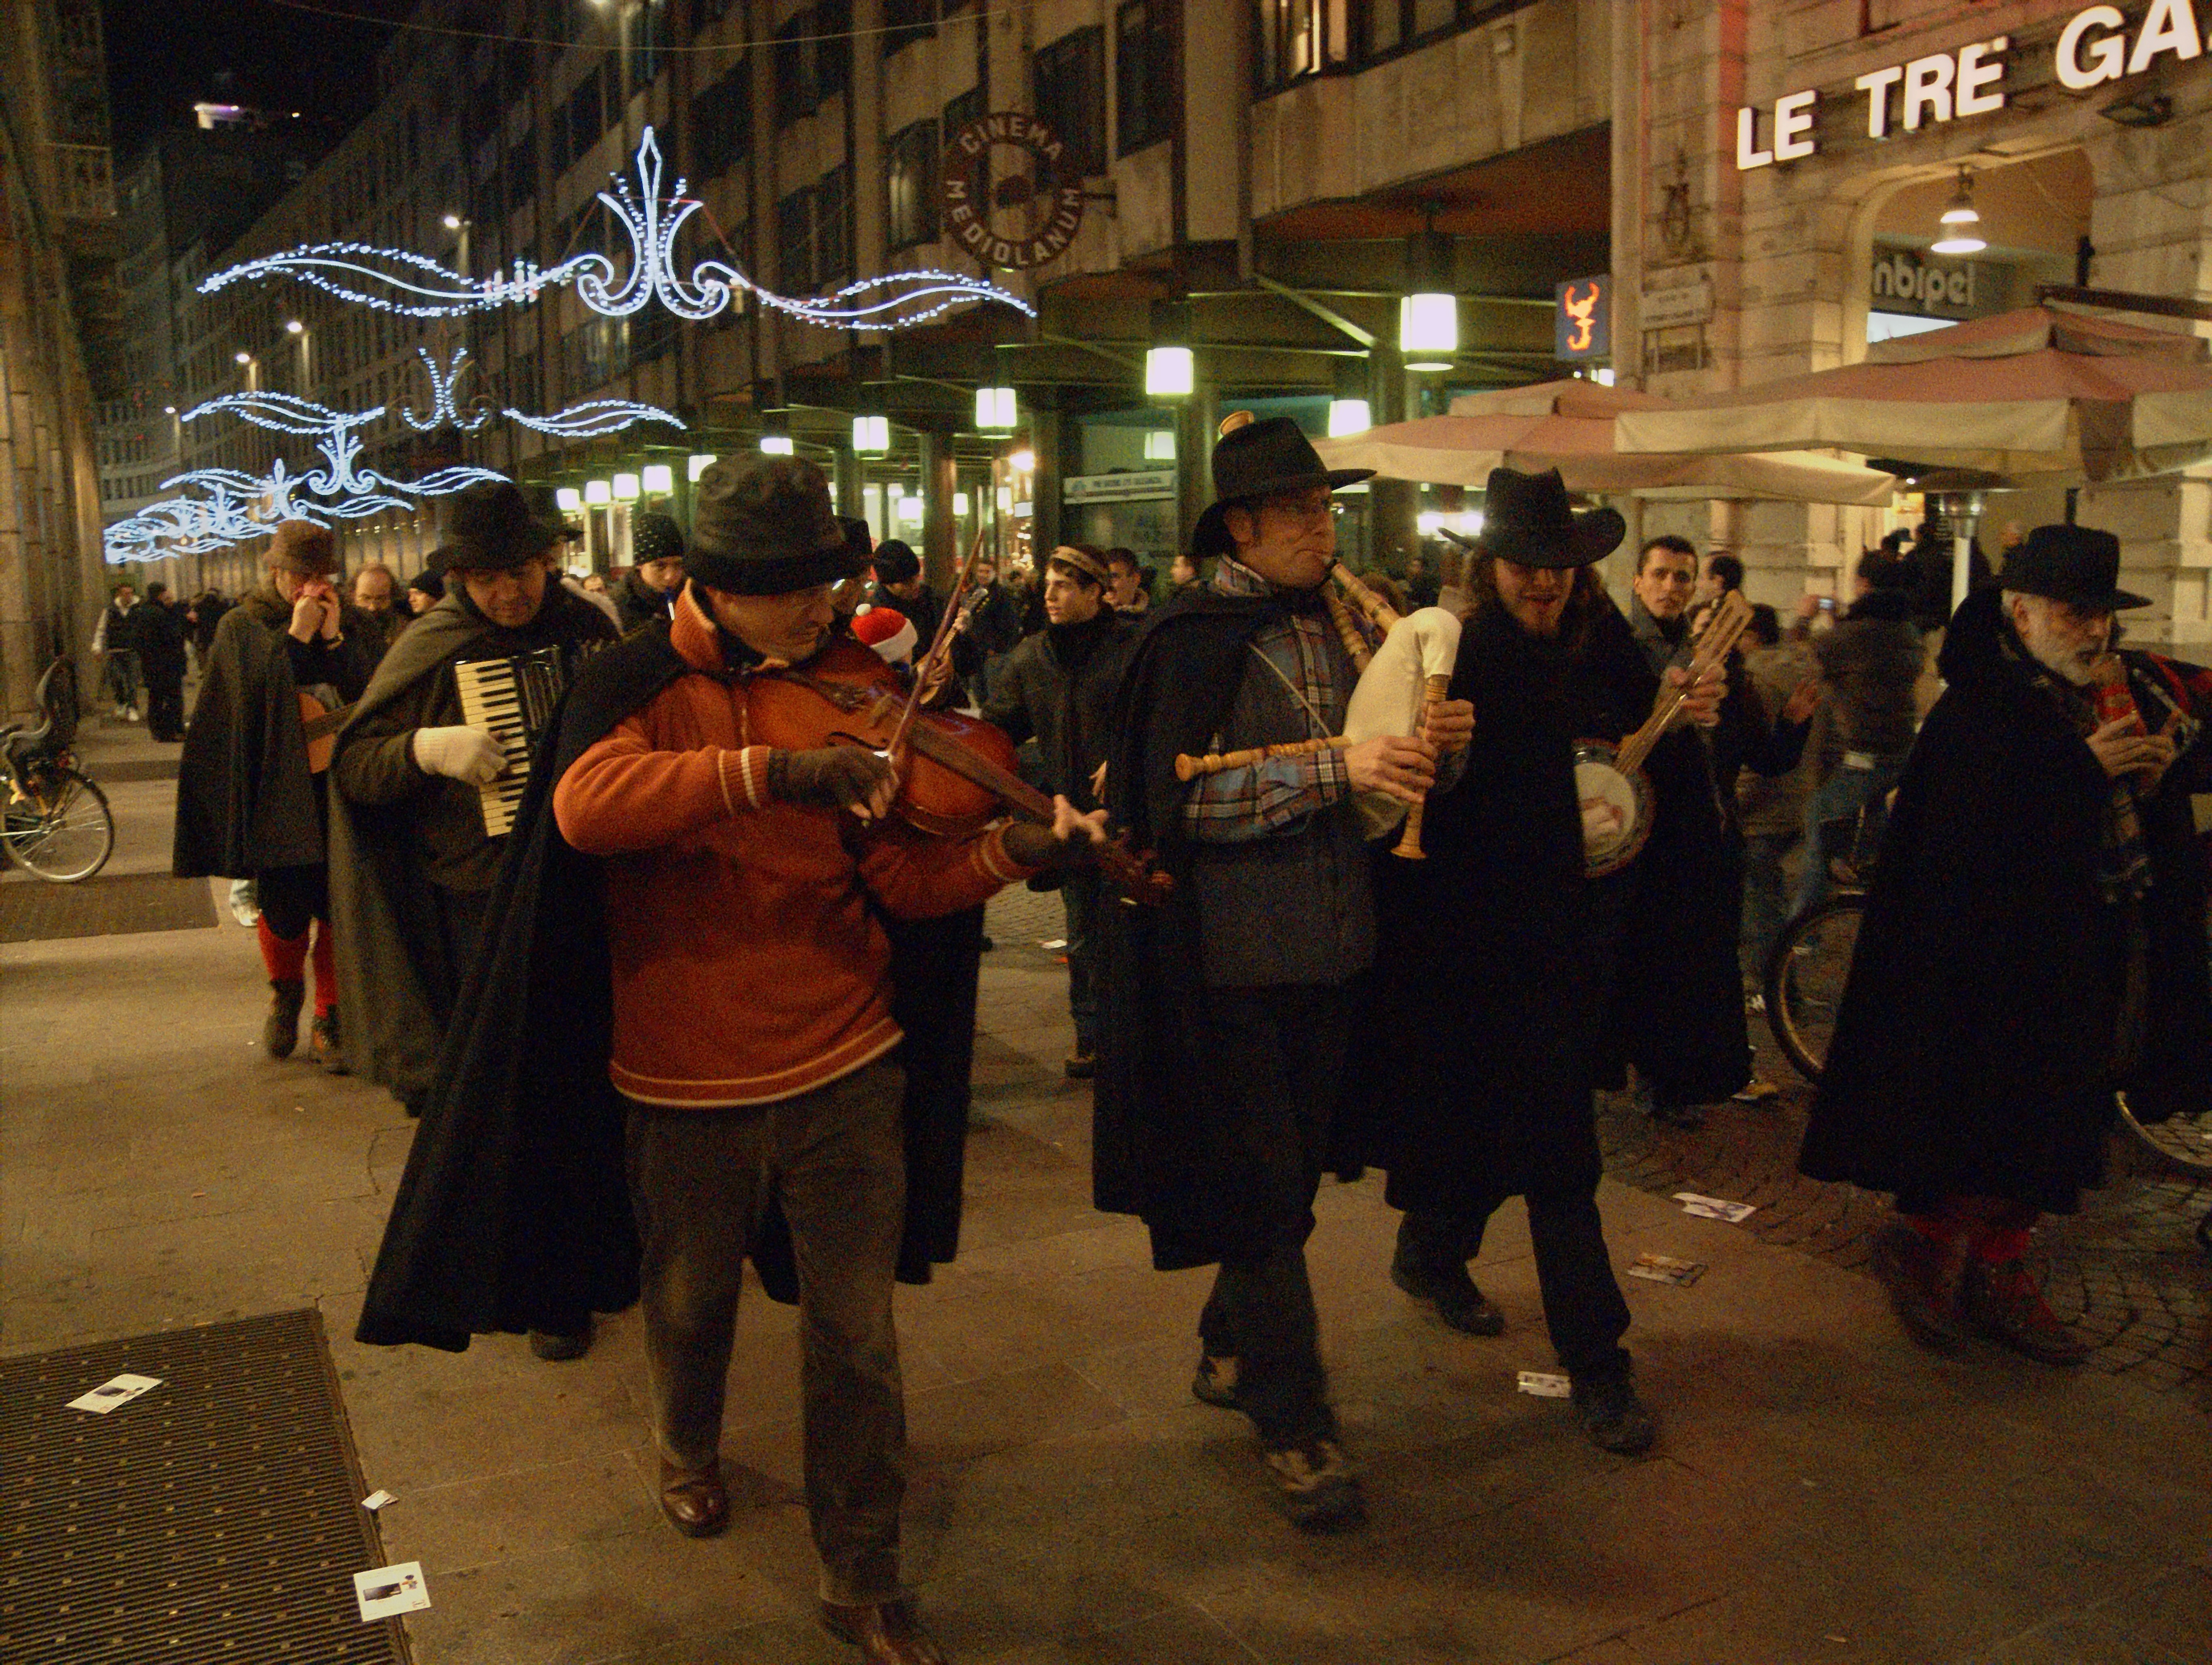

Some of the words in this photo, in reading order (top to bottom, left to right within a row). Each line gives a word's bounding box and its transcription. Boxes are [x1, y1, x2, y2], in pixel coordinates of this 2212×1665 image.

[1737, 90, 1816, 170] LE
[1855, 36, 2009, 138] TRE
[2055, 0, 2212, 90] GA
[959, 117, 1063, 160] CINEMA
[946, 180, 1081, 265] MEDIOLANUM
